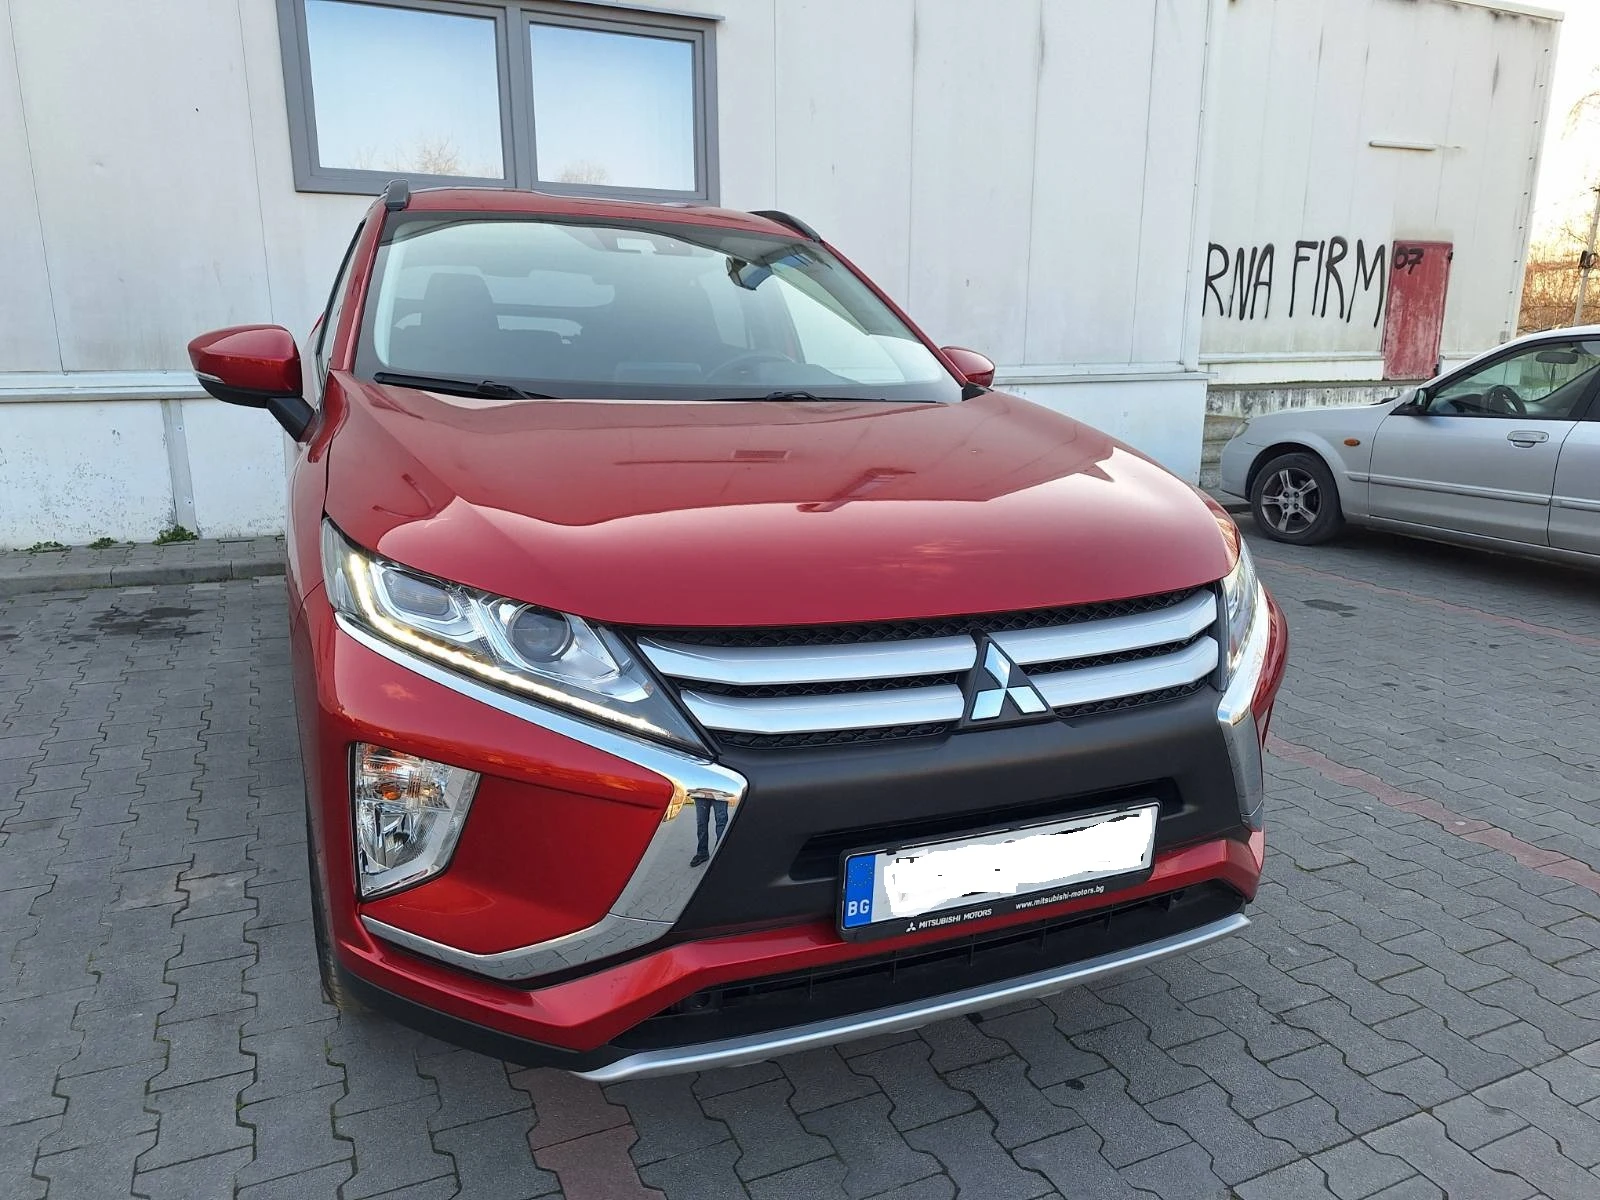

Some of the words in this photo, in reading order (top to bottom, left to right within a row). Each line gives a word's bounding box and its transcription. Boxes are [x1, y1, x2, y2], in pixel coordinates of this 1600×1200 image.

[1202, 242, 1274, 320] RNA
[1289, 235, 1386, 328] FIRM
[1394, 246, 1424, 275] 07
[847, 899, 870, 917] BG
[1015, 885, 1105, 909] www.mitsubishi-motors.bg
[918, 914, 961, 929] MITSUBISHI
[963, 908, 993, 921] MOTORS
